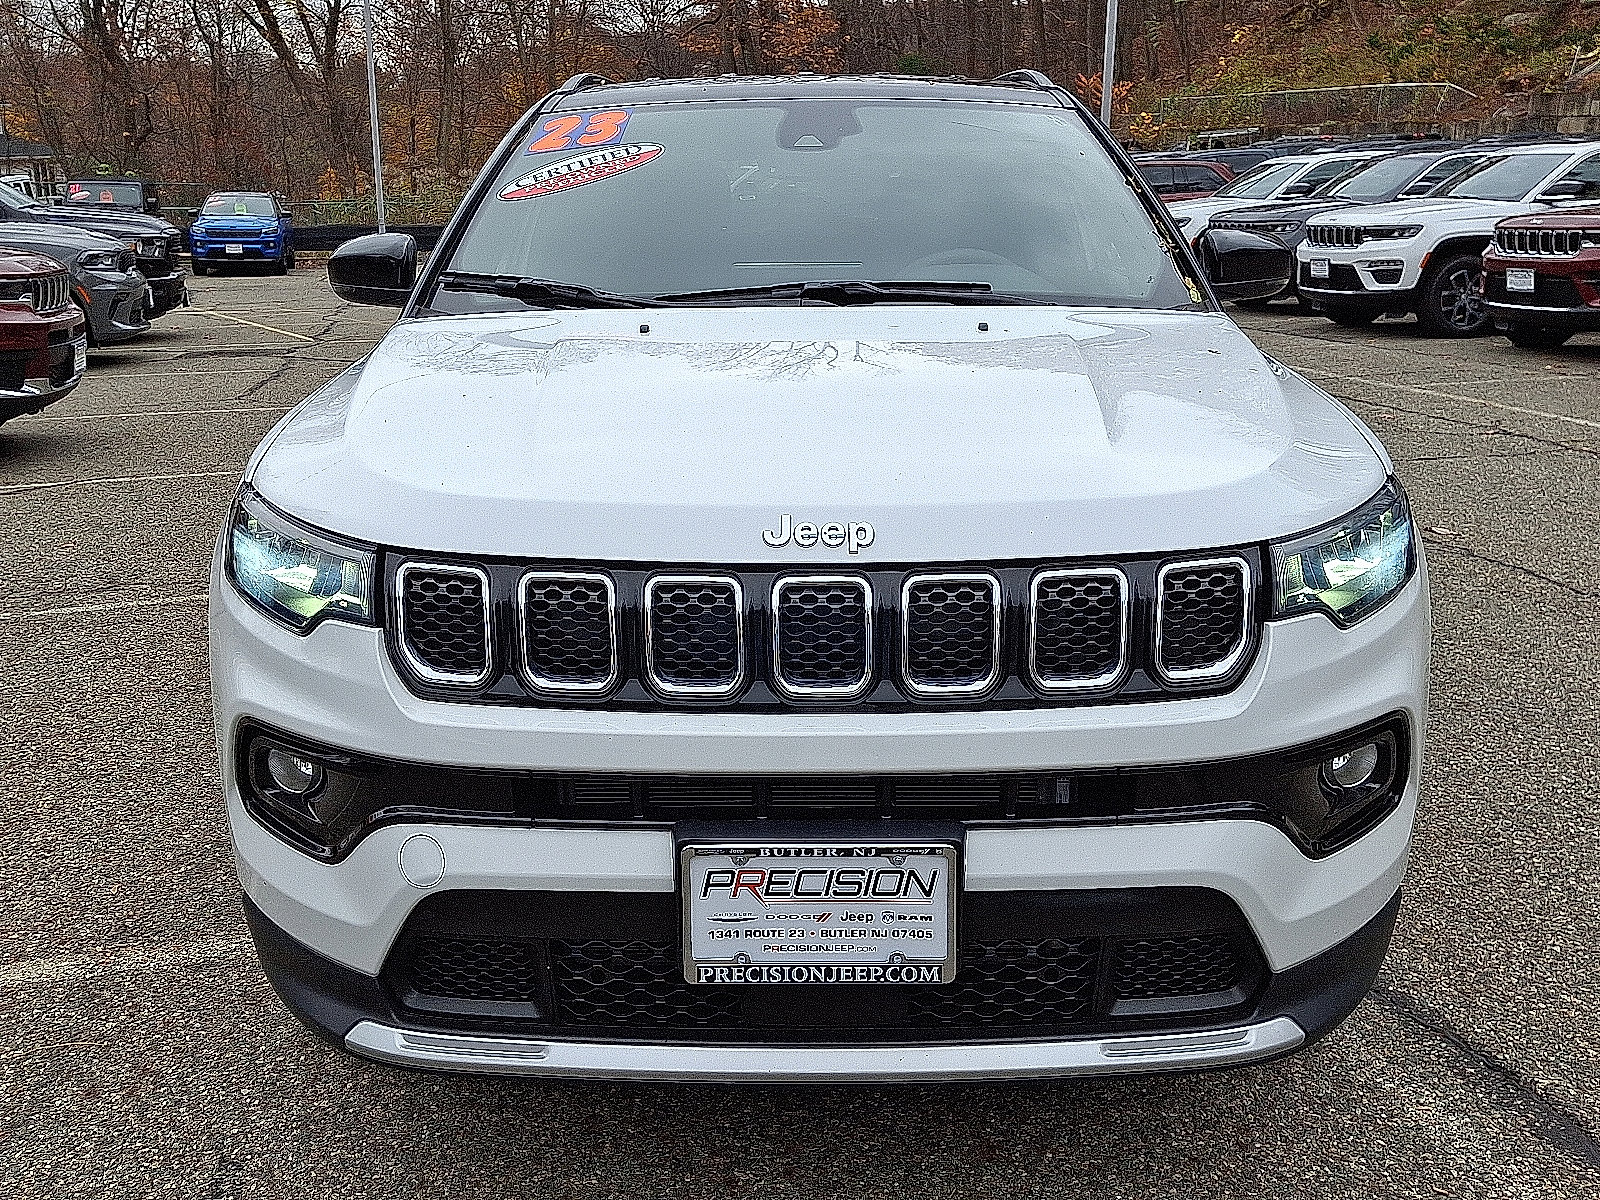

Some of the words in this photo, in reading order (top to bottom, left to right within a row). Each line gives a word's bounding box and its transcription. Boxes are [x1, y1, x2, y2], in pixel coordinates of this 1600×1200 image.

[528, 110, 629, 152] 23
[515, 145, 642, 187] CERTIFIED
[762, 513, 875, 554] Jeep
[852, 847, 877, 857] NJ
[699, 867, 941, 908] PRECISION
[764, 913, 823, 921] DODGE
[840, 910, 875, 924] Jeep
[897, 914, 934, 922] RAM
[707, 929, 741, 940] 1341
[744, 928, 786, 939] ROUTE
[788, 928, 806, 939] 23
[820, 929, 868, 938] BUTLER
[870, 929, 889, 938] NJ
[891, 929, 934, 939] 07405
[698, 966, 941, 983] PRECISIONJEEP.COM
